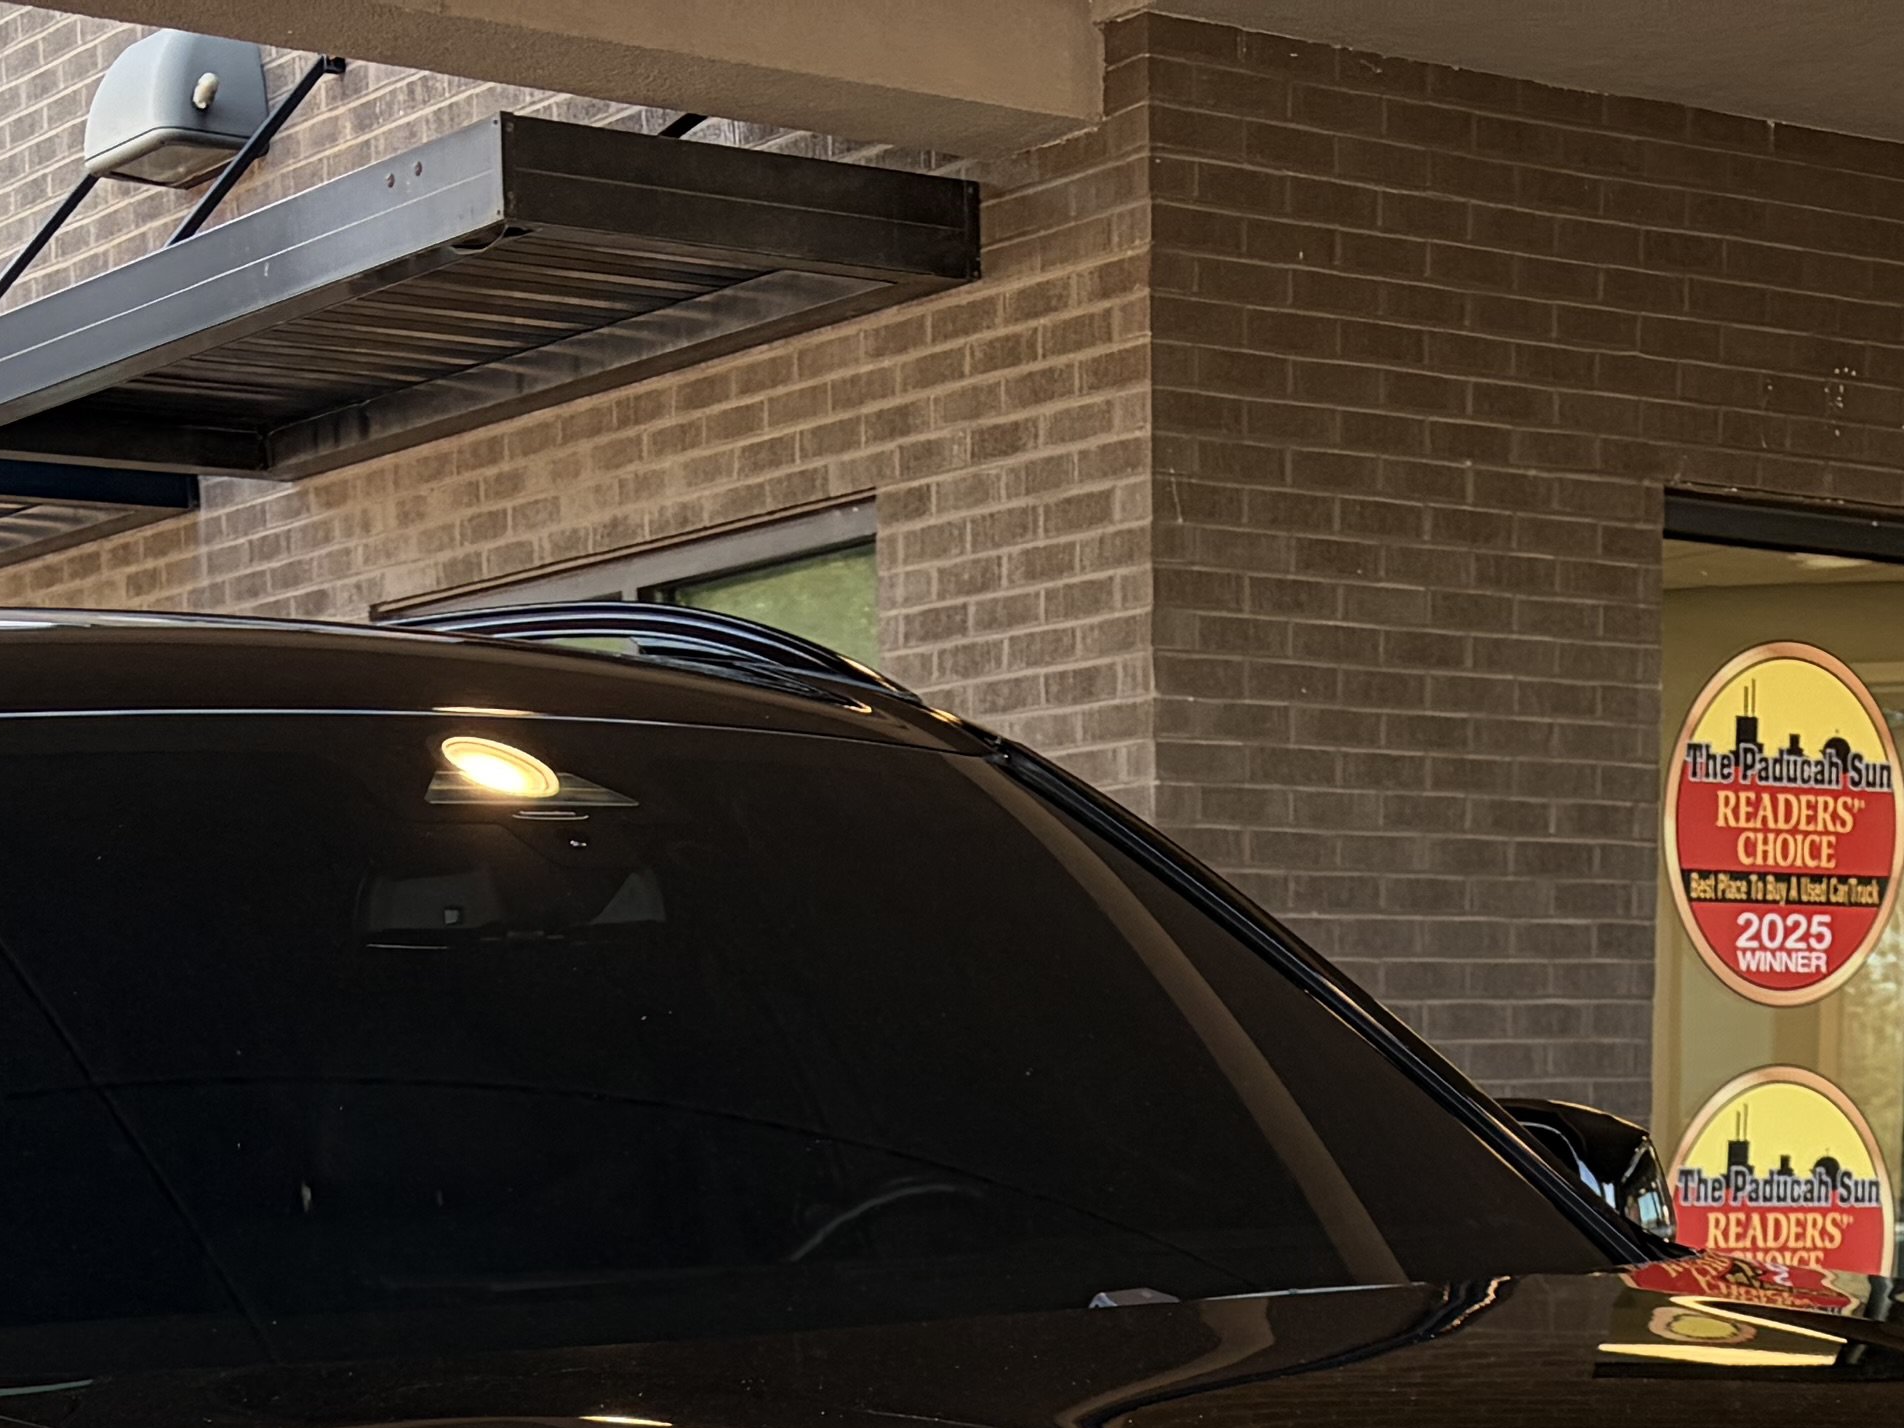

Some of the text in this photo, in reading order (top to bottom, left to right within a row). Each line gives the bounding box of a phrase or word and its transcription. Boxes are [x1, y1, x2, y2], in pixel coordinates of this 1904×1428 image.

[1687, 743, 1892, 791] The Paducah Sun
[1737, 831, 1837, 868] CHOICE
[1690, 873, 1715, 899] Best
[1718, 873, 1747, 899] Place
[1766, 875, 1788, 906] Buy
[1790, 876, 1797, 901] A
[1800, 876, 1827, 902] Used
[1735, 912, 1833, 950] 2025
[1736, 950, 1827, 974] WINNER
[1678, 1165, 1882, 1207] The Paducah Sun
